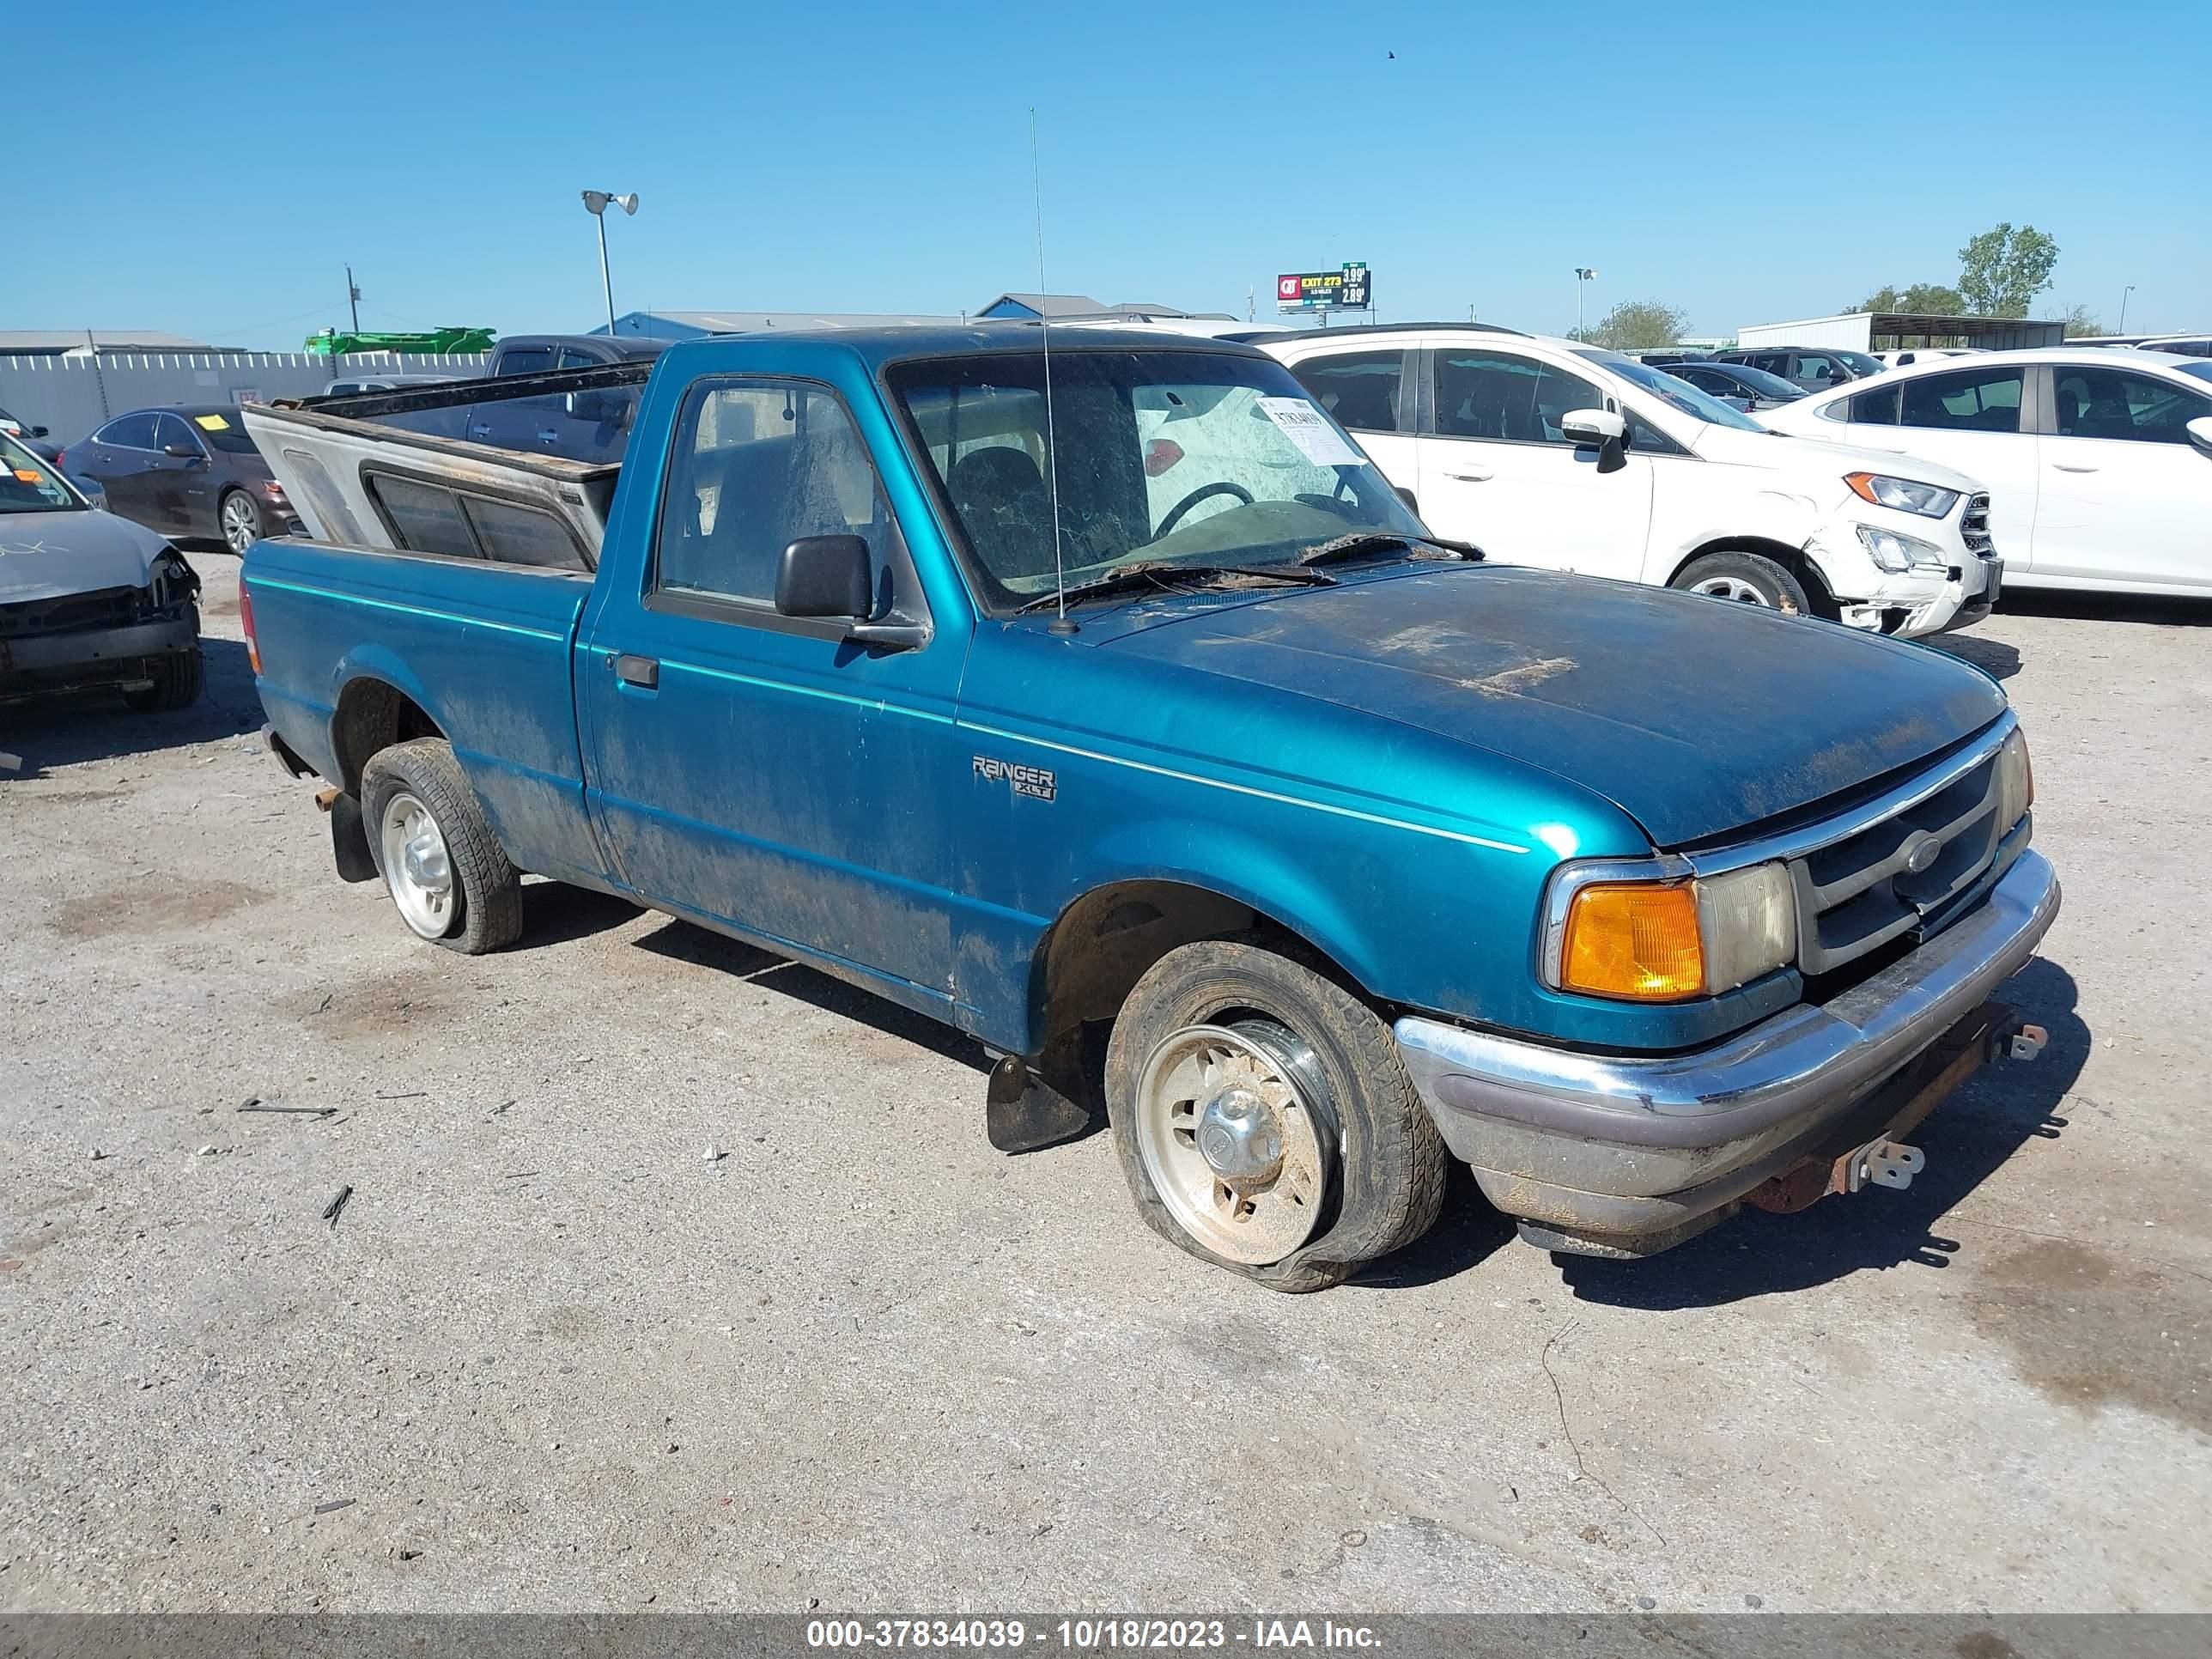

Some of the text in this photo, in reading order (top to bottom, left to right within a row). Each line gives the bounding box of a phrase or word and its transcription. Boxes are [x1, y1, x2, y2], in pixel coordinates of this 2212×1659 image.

[1280, 279, 1297, 295] QT
[1301, 277, 1322, 288] EXIT
[1323, 276, 1342, 287] 273
[1273, 412, 1322, 426] 37834039
[972, 755, 1054, 787] RANGER
[1018, 783, 1048, 796] XLT
